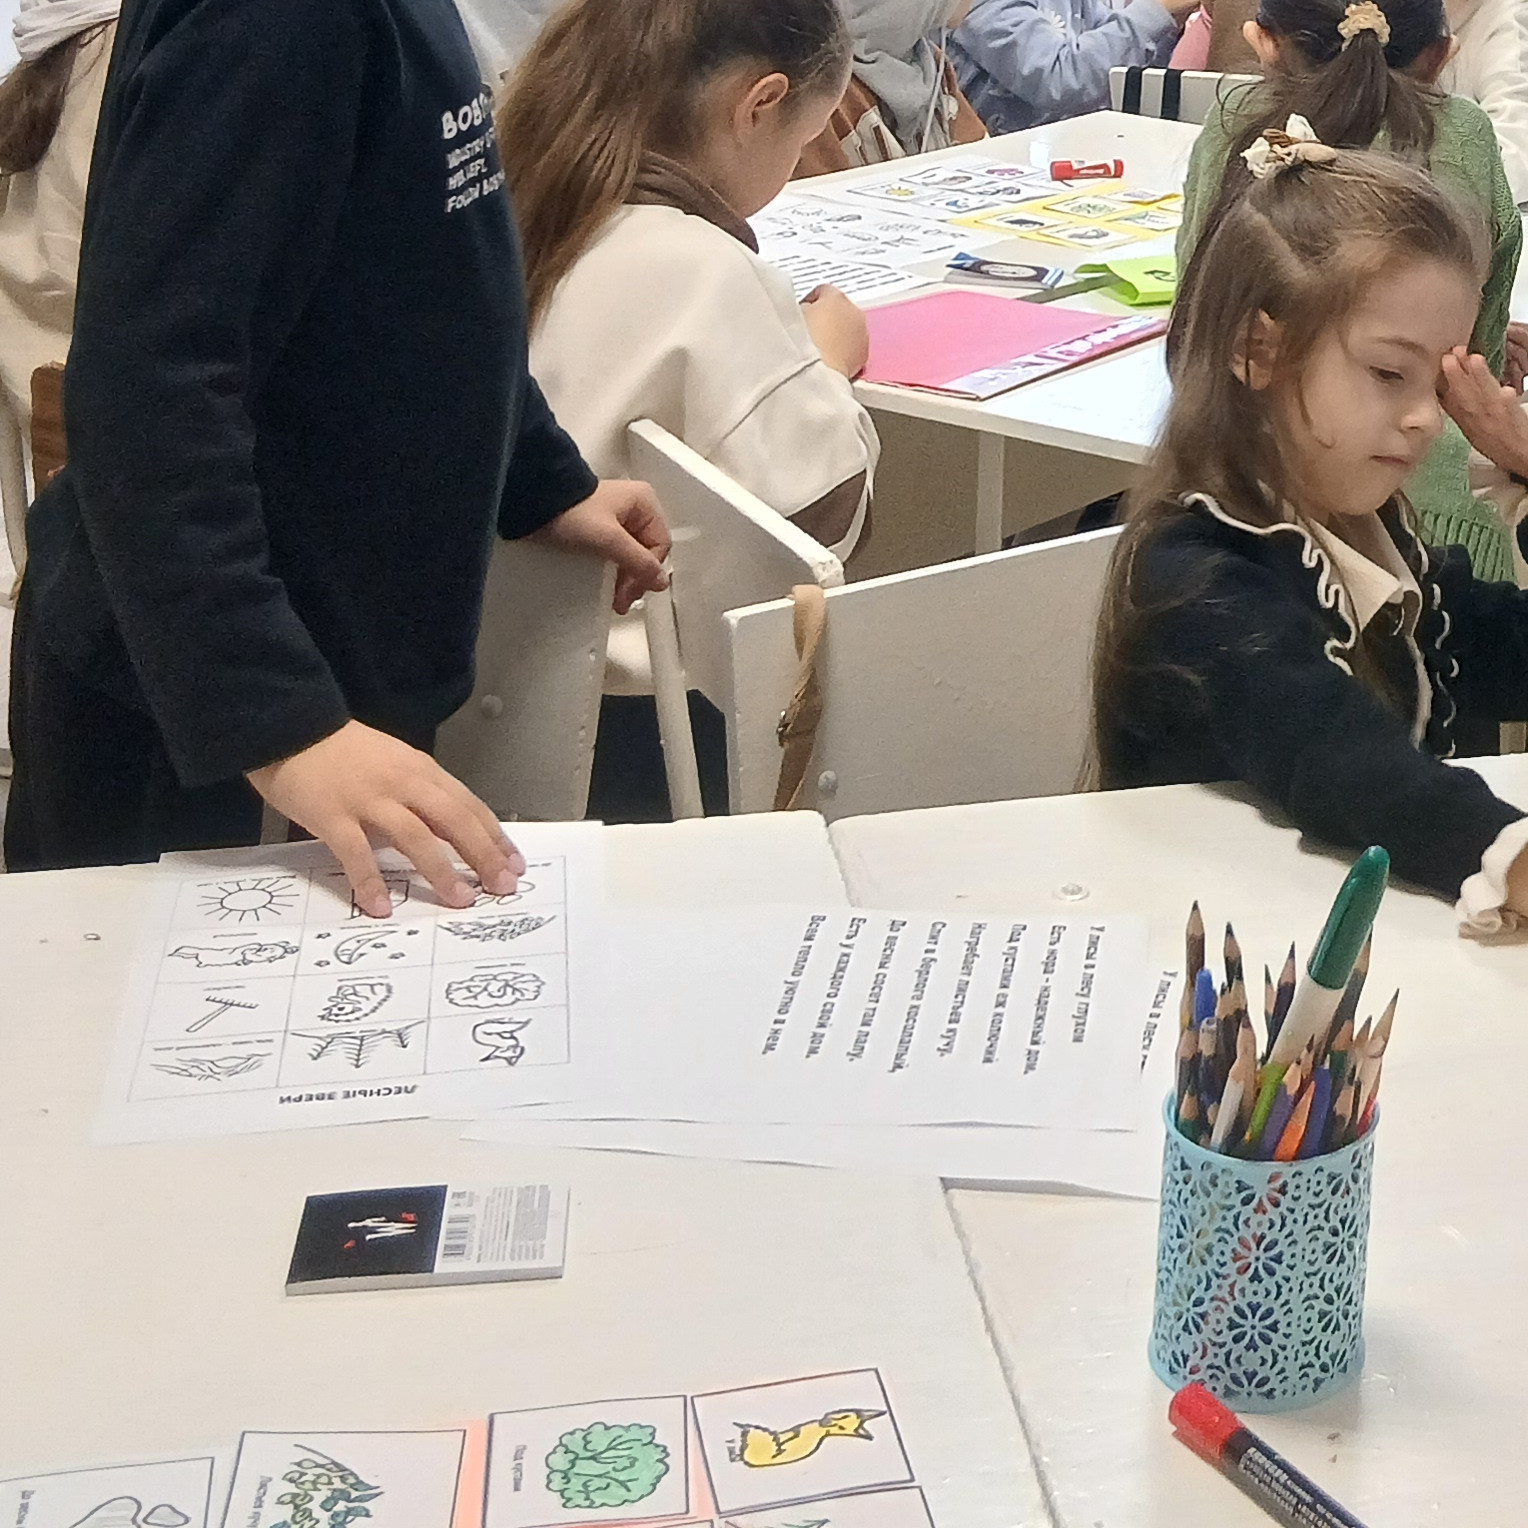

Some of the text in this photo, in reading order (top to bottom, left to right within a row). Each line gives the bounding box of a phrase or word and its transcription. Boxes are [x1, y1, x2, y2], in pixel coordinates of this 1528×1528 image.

[803, 914, 827, 942] Всем
[844, 917, 868, 941] Есть
[887, 919, 908, 933] До
[926, 921, 948, 946] Спит
[1048, 924, 1067, 947] Есть
[838, 942, 856, 950] у
[877, 935, 899, 970] весны
[959, 922, 988, 977] Нагребает
[1085, 933, 1101, 961] лисы
[790, 944, 813, 977] тепло
[1040, 948, 1058, 975] нора
[1162, 970, 1179, 978] У
[825, 951, 852, 999] каждого
[867, 972, 888, 1004] сосет
[910, 956, 938, 1001] берлоге
[1074, 971, 1095, 999] лесу
[776, 979, 801, 1015] уютно
[947, 978, 970, 1025] листьев
[981, 923, 1028, 1064] Под кустами еж колючий
[815, 1001, 836, 1029] свой
[859, 1006, 878, 1027] там
[1029, 985, 1052, 1046] надежный
[1071, 1001, 1090, 1043] глухом
[279, 1084, 418, 1104] ЛЕСНЫЕ ЗВЕРИ
